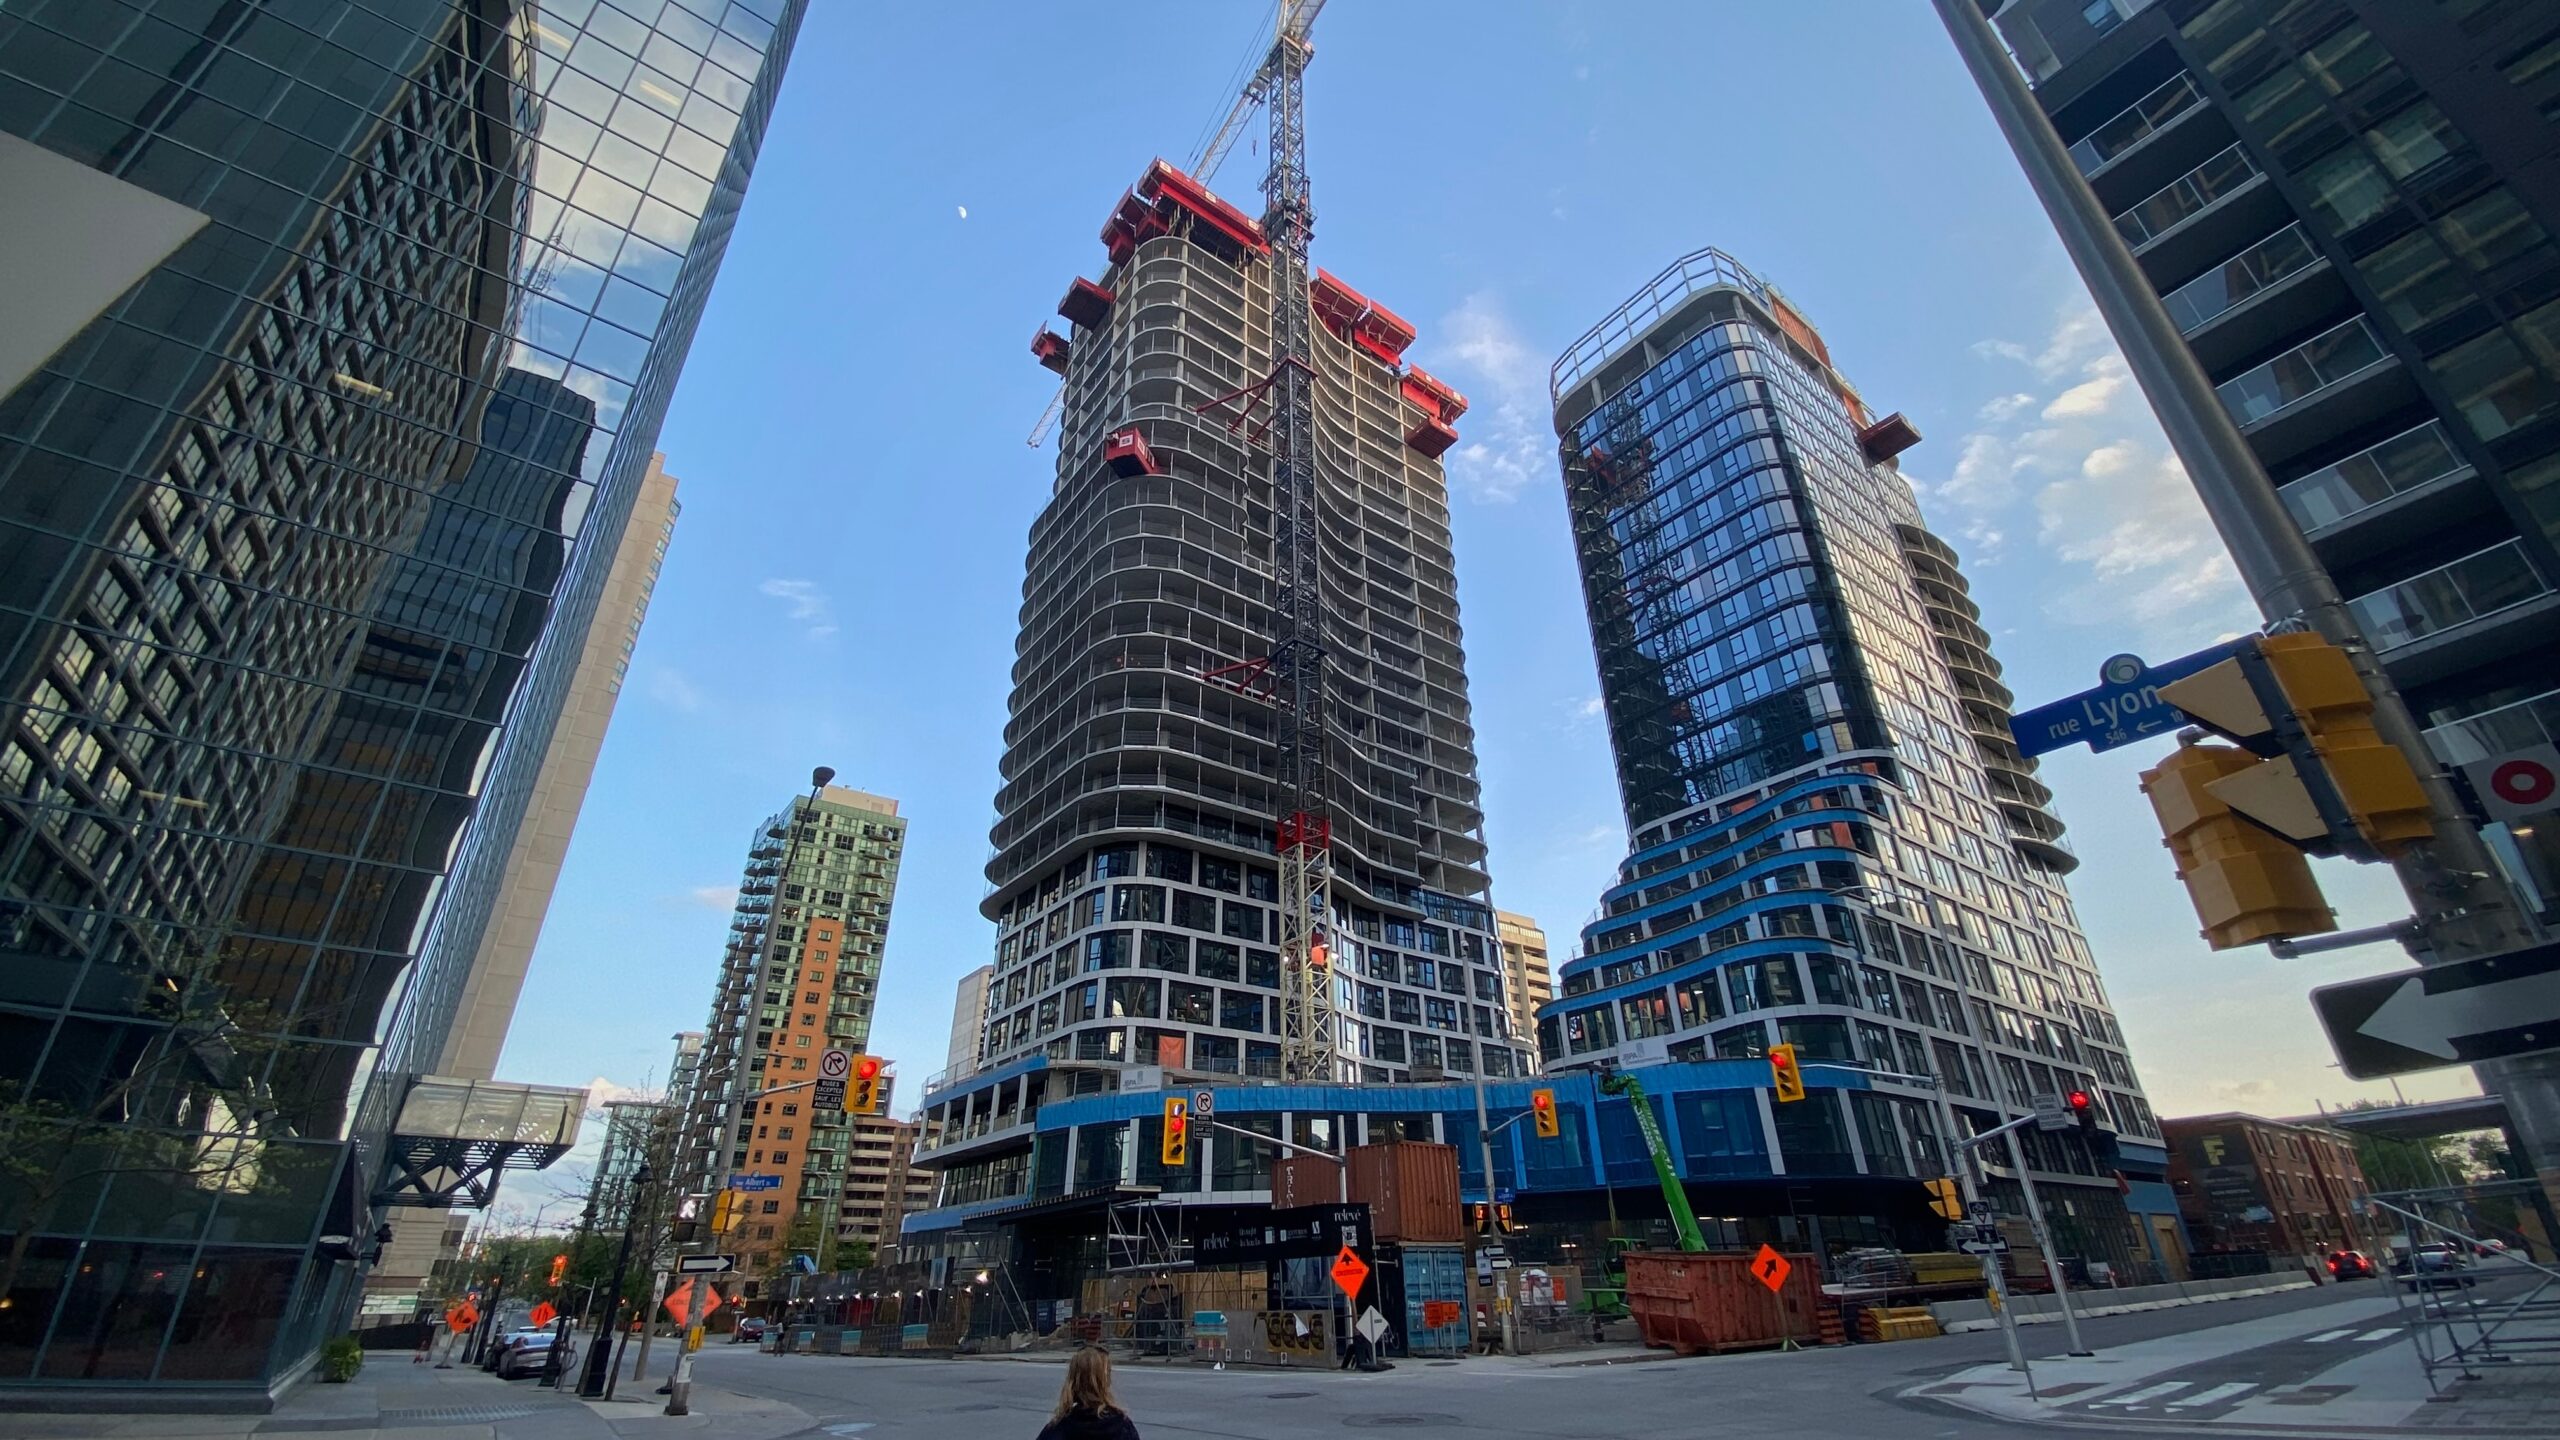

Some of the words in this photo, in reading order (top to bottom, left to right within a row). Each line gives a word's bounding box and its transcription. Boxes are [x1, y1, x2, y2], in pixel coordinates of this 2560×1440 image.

[2048, 717, 2081, 740] rue
[2082, 685, 2164, 730] Lyon
[2105, 728, 2128, 745] 546
[821, 1080, 840, 1088] BUSES
[816, 1086, 843, 1094] EXCEPTED
[814, 1101, 839, 1109] AUTOBUS
